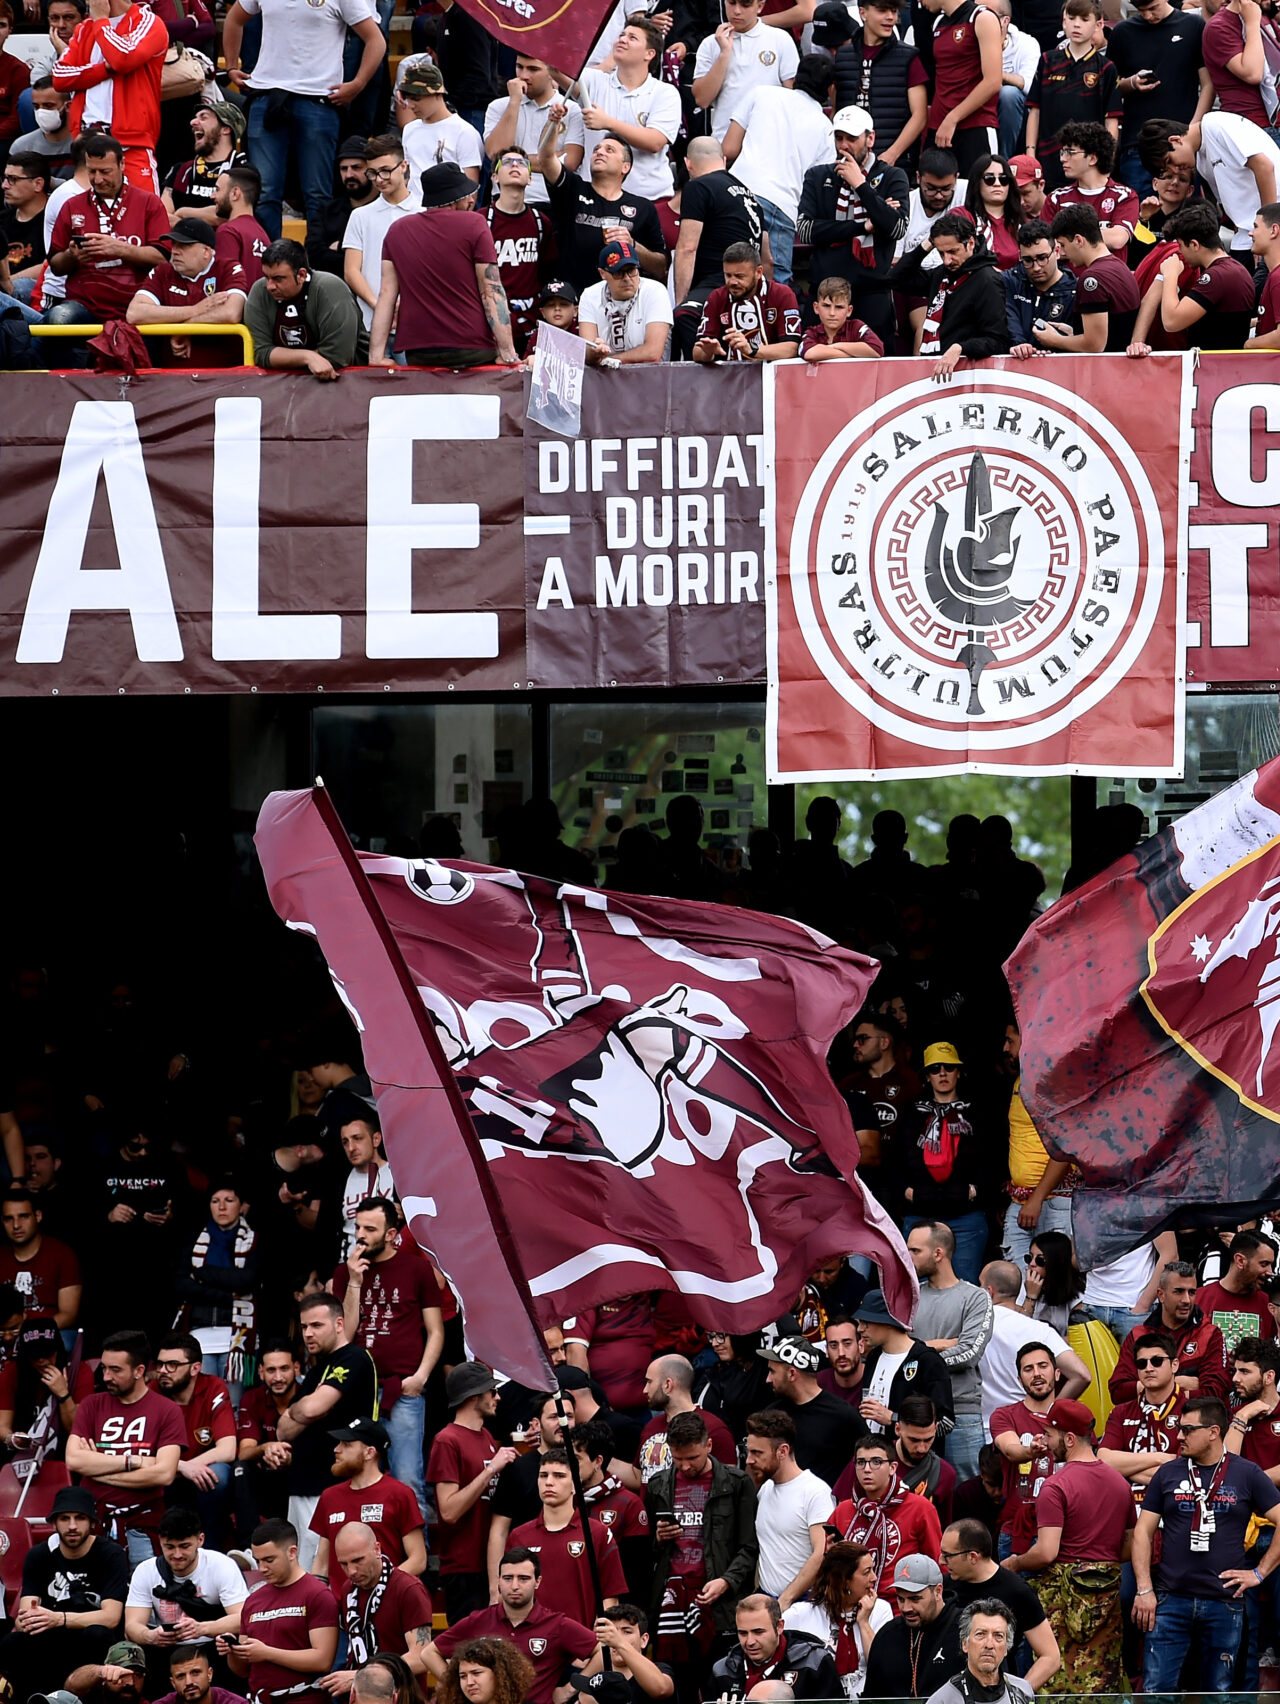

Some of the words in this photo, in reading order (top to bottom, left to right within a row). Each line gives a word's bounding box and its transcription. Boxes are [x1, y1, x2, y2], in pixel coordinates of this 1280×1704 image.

[538, 435, 765, 494] DIFFIDAT
[863, 403, 1087, 483] SALERNO
[15, 394, 501, 664] ALE
[605, 495, 727, 550] DURI
[842, 481, 867, 541] 1919
[537, 556, 575, 611] A
[595, 550, 760, 609] MORIR
[993, 493, 1121, 706] PAESTUM
[831, 551, 960, 707] ULTRAS
[106, 1177, 166, 1188] GIVENCHY
[100, 1416, 147, 1442] SA
